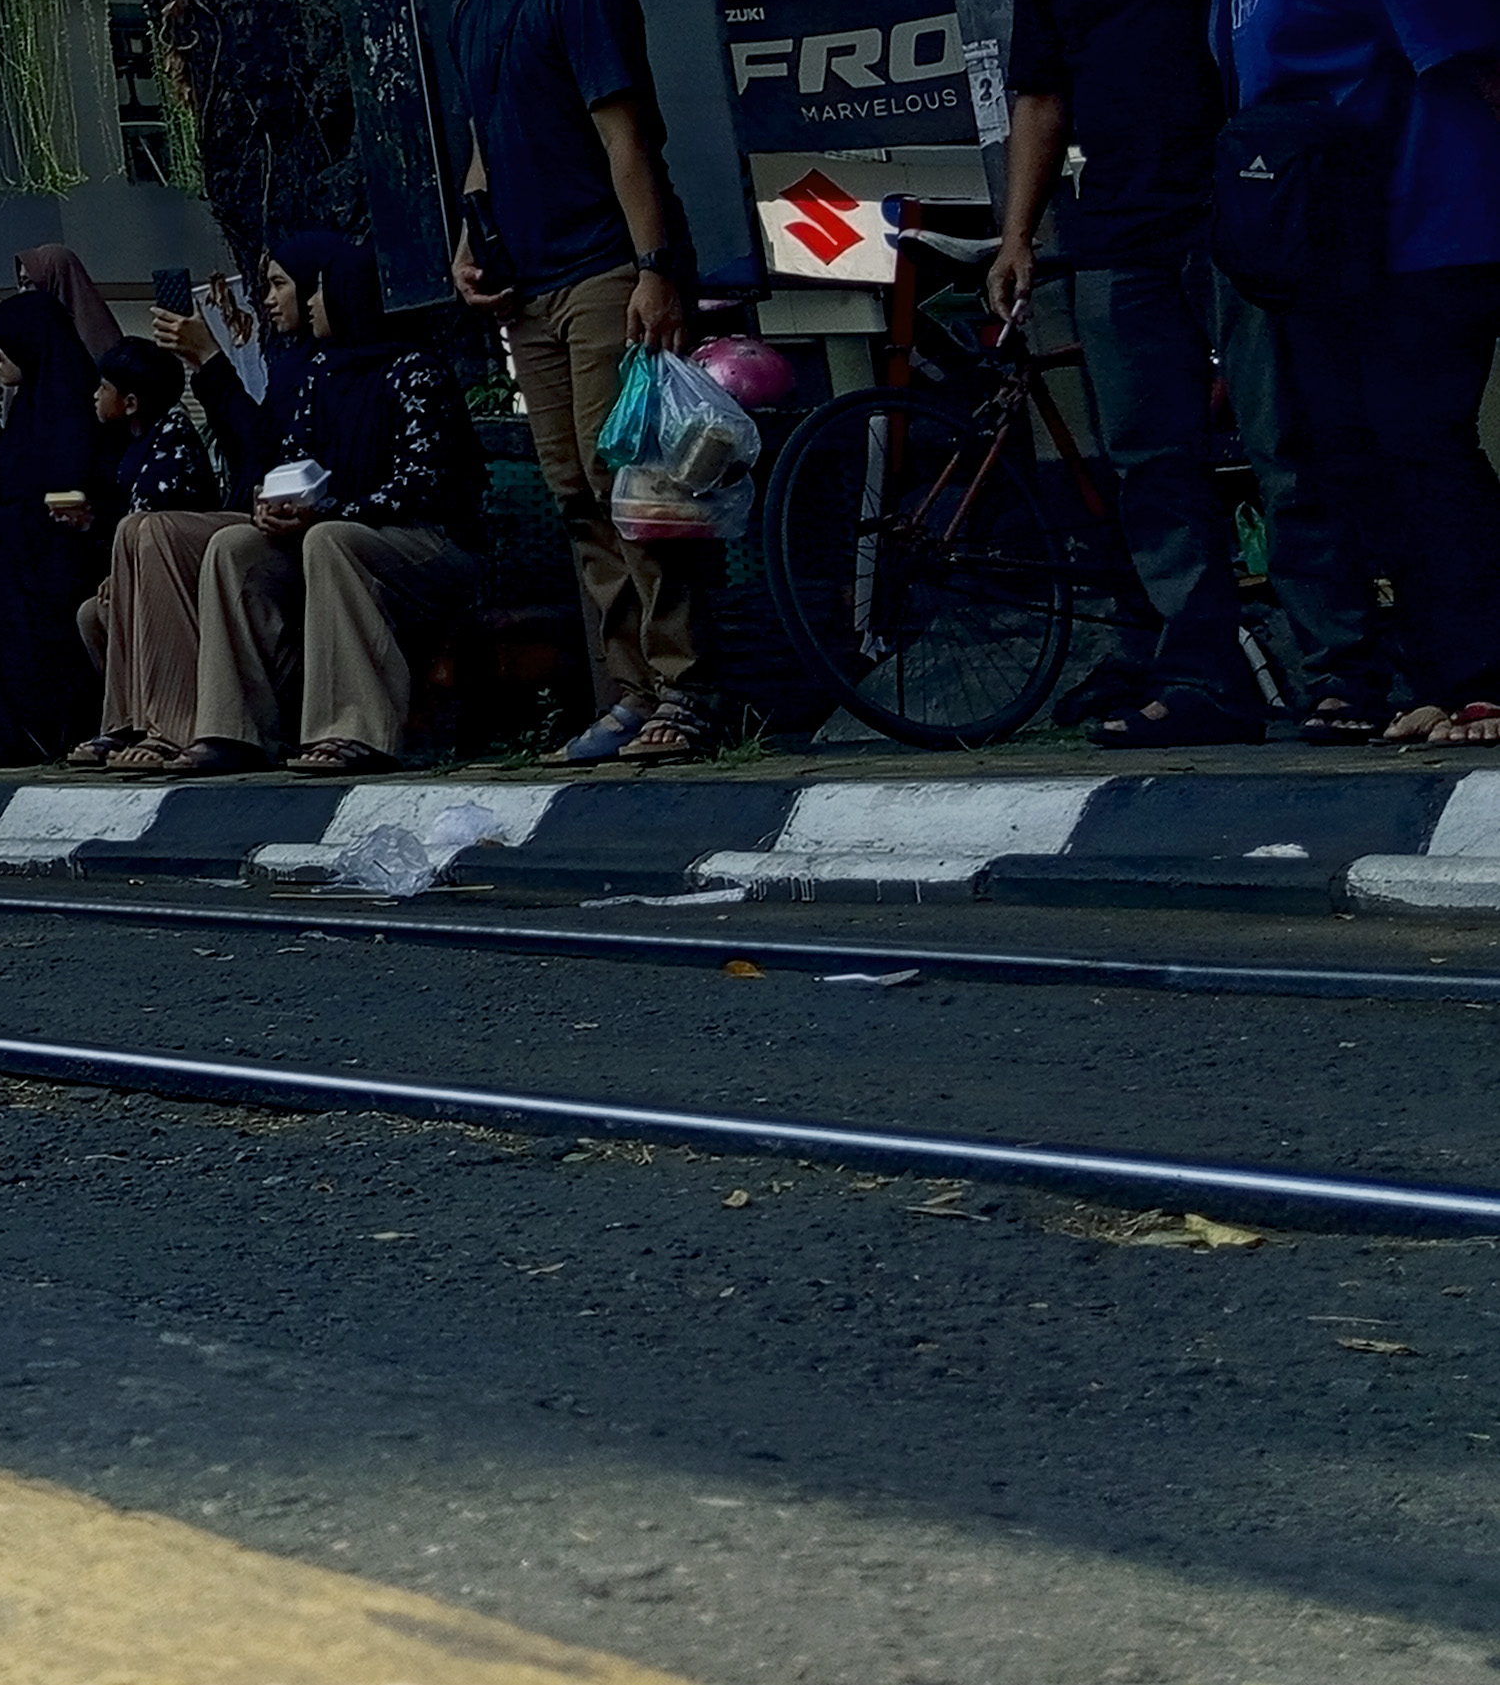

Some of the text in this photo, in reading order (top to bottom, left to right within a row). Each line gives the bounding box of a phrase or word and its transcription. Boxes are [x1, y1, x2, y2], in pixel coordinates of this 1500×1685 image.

[726, 6, 766, 24] ZUKI
[729, 11, 968, 97] FRO
[800, 88, 958, 123] MARVELOUS
